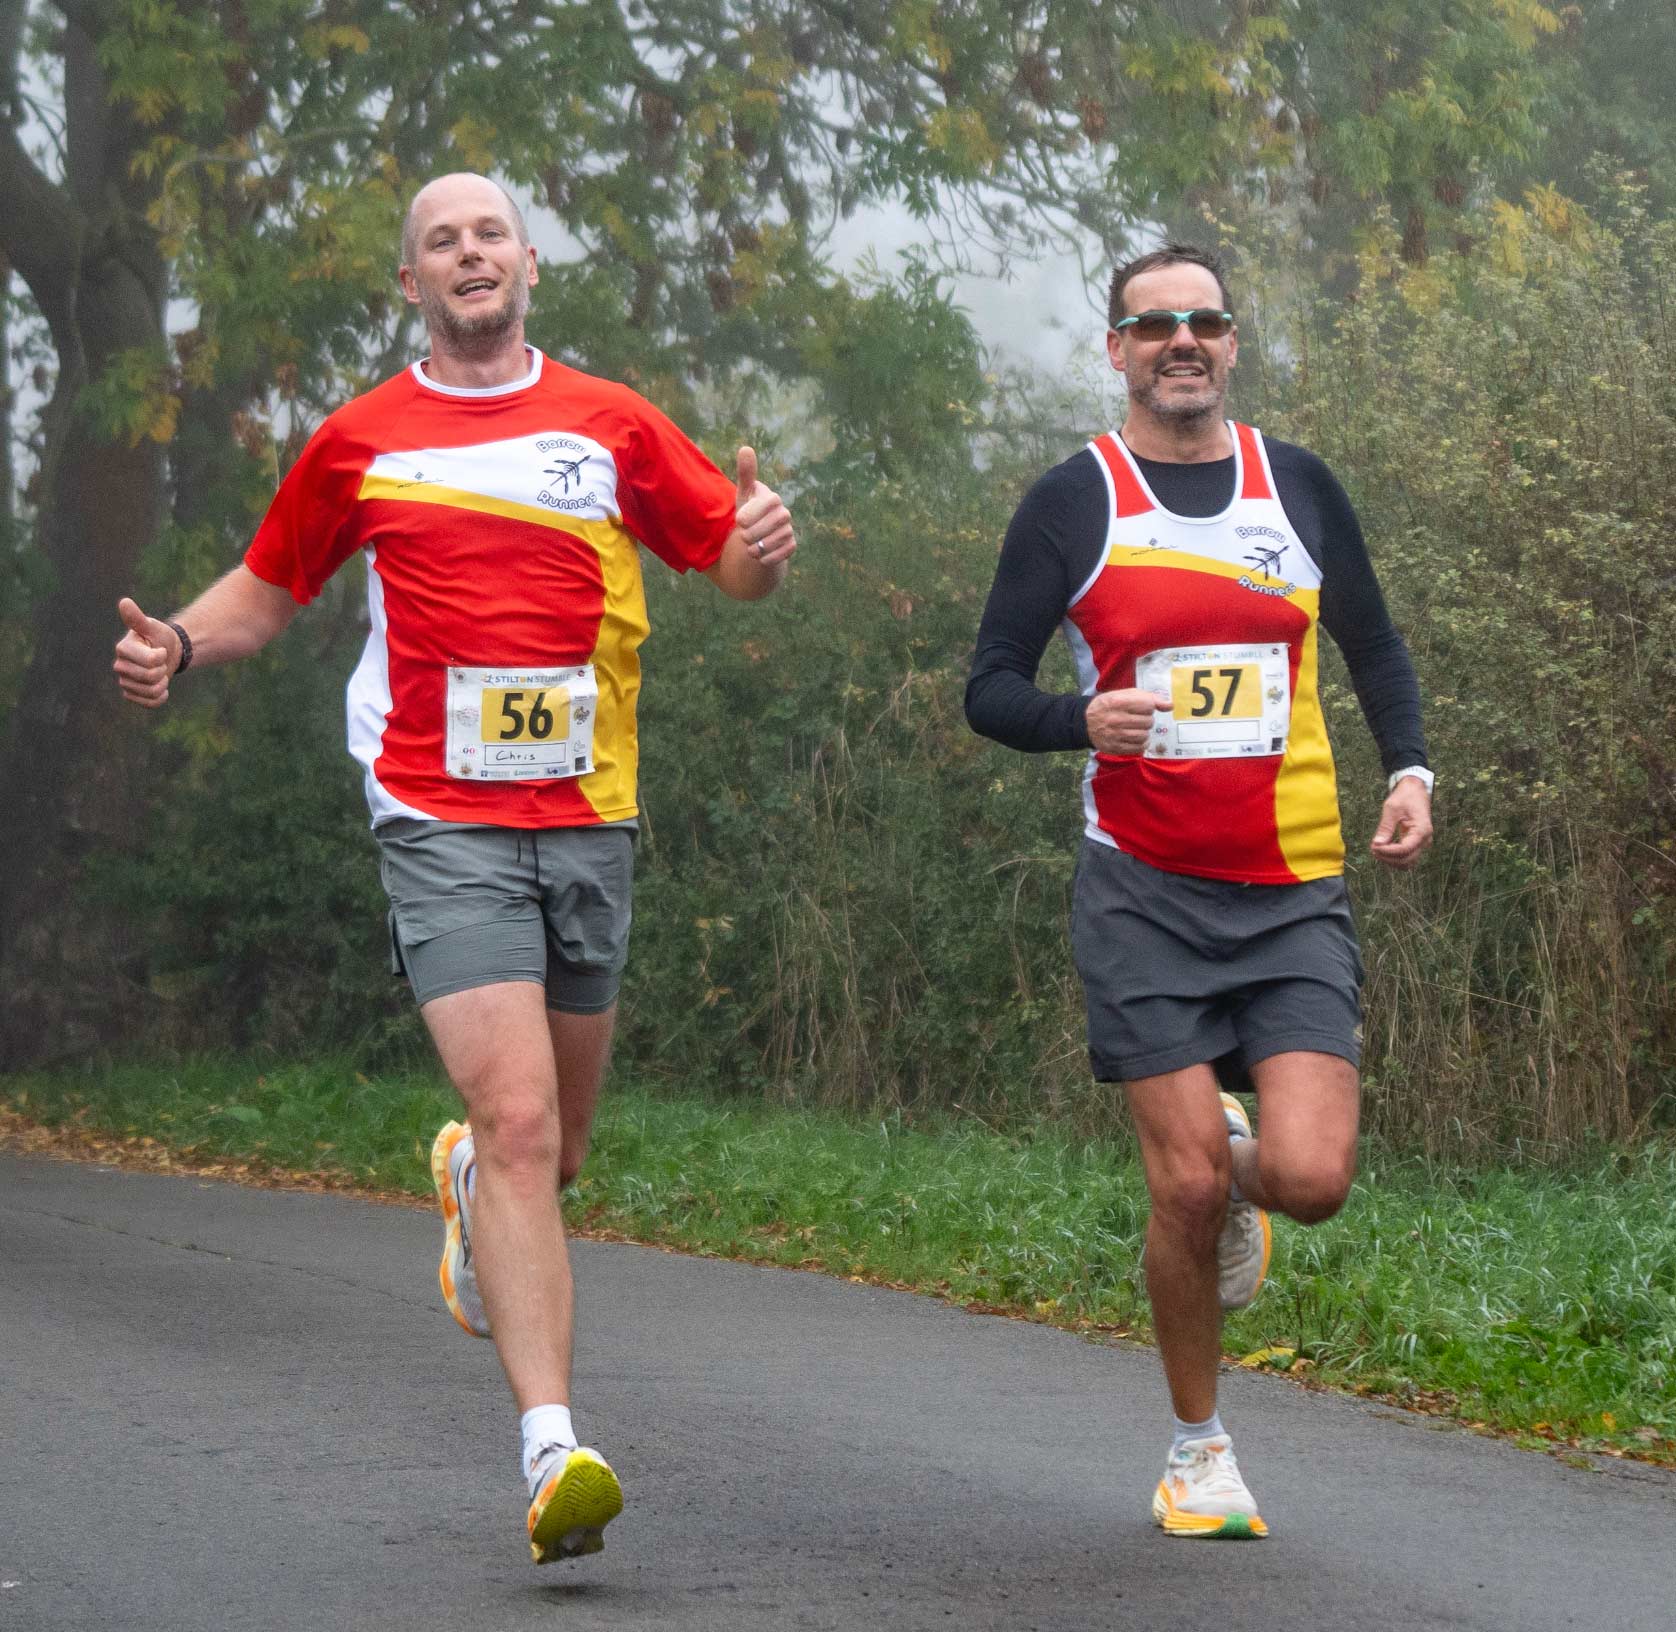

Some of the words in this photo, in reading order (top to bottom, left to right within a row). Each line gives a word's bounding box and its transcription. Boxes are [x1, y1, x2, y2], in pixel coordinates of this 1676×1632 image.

[536, 438, 586, 453] Barrow
[537, 490, 597, 509] Runners
[1235, 526, 1286, 543] Barrow
[1238, 574, 1297, 597] Runners
[1182, 652, 1220, 661] STILTON
[495, 675, 534, 684] STILTON
[534, 673, 571, 684] STUMBLE
[1191, 668, 1243, 717] 57
[500, 692, 554, 740] 56
[495, 750, 536, 762] Chris
